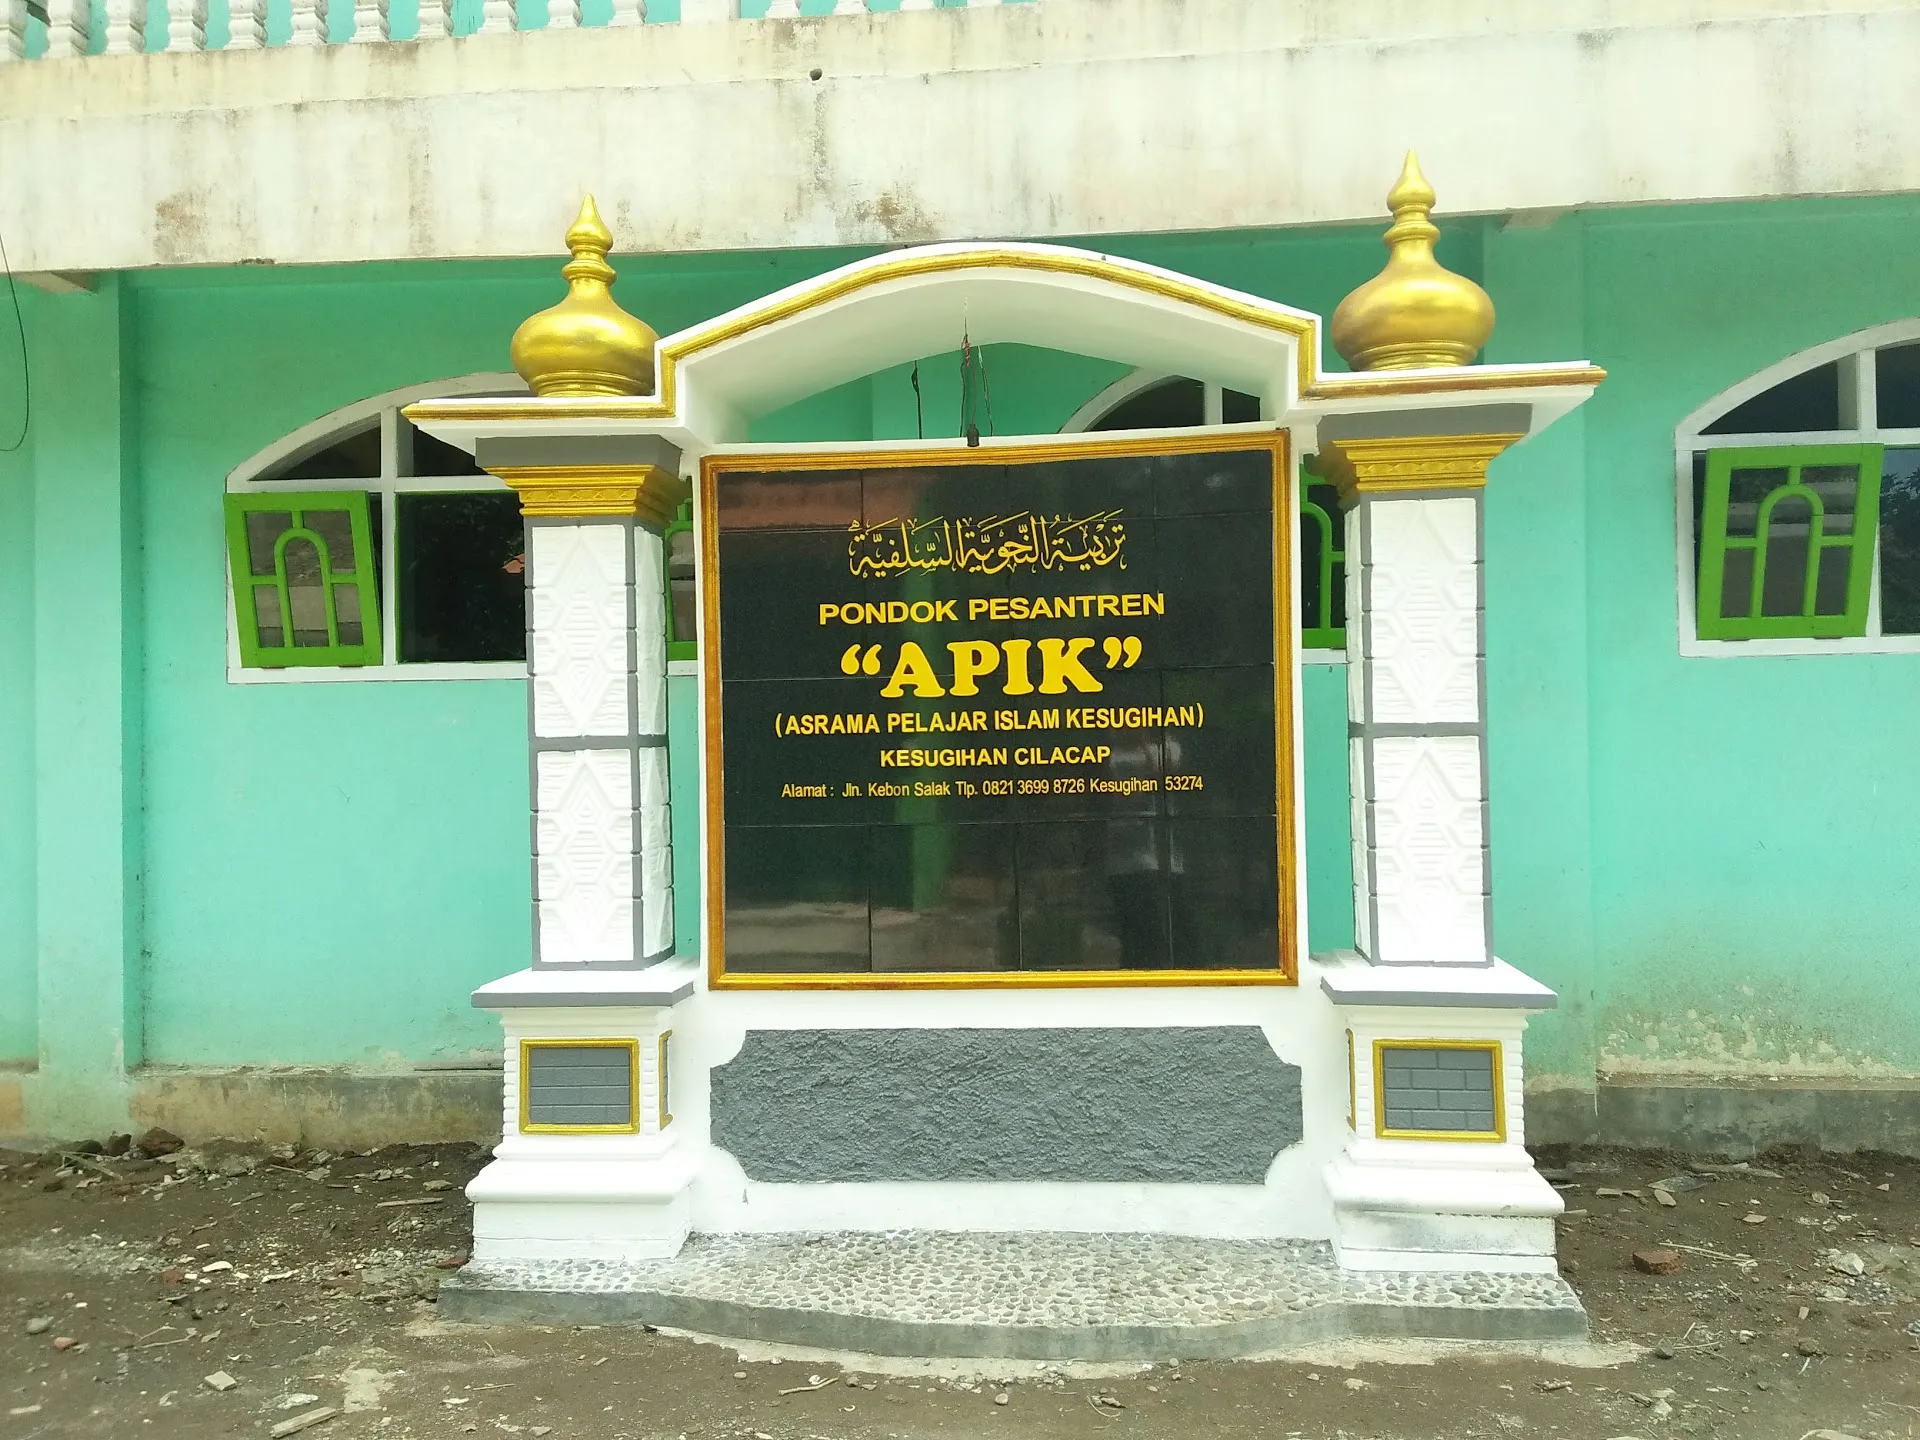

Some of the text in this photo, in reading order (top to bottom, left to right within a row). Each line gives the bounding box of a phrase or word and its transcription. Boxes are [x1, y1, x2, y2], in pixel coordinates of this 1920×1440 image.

[819, 593, 1165, 625] PONDOK PESANTREN
[775, 702, 1204, 737] (ASRAMA PELAJAR ISLAM KESUGIHAN)
[880, 745, 1111, 768] KESUGIHAN CILACAP
[868, 782, 910, 797] Kebon
[914, 781, 951, 797] Salak
[983, 780, 1014, 796] 0821
[1017, 780, 1049, 795] 3699
[1053, 779, 1085, 794] 8726
[1089, 777, 1158, 797] Kesugihan
[1164, 775, 1204, 792] 53274
